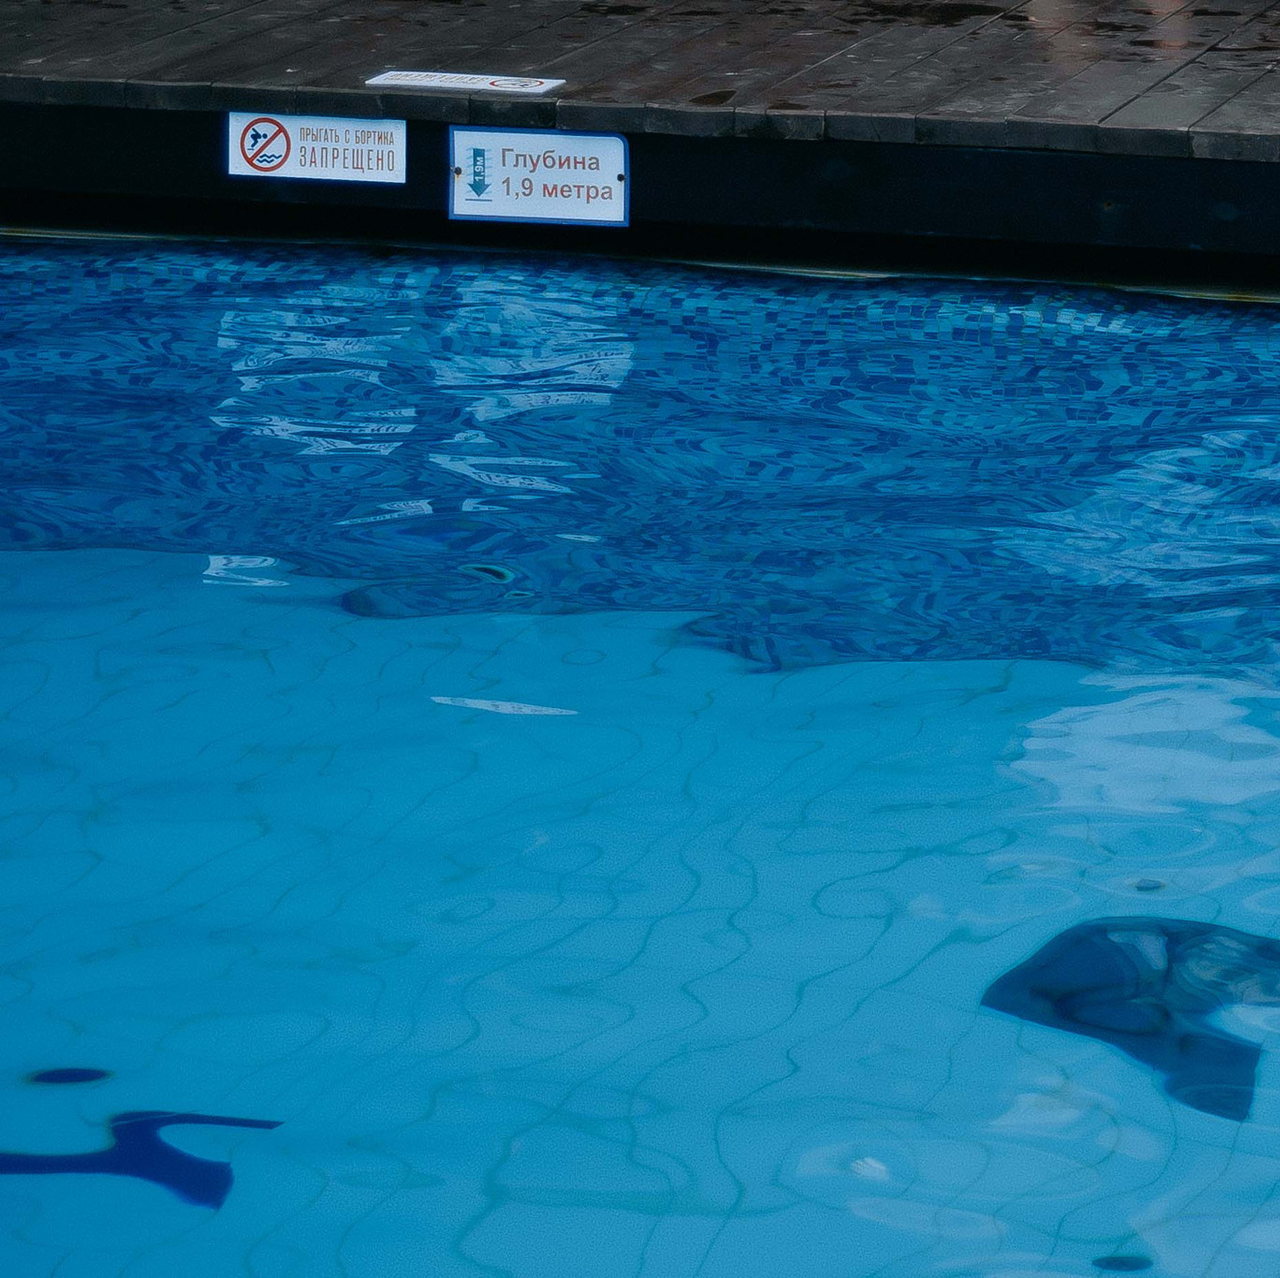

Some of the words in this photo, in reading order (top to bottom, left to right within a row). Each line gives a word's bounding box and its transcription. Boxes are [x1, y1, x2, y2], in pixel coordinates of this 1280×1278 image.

[300, 127, 340, 143] ПРЫГАТЬ
[344, 129, 351, 144] С
[355, 130, 395, 145] БОРТИКА
[300, 146, 395, 173] ЗАПРЕЩЕНО
[501, 148, 600, 173] Глубина
[501, 177, 534, 200] 1,9
[542, 184, 613, 204] метра
